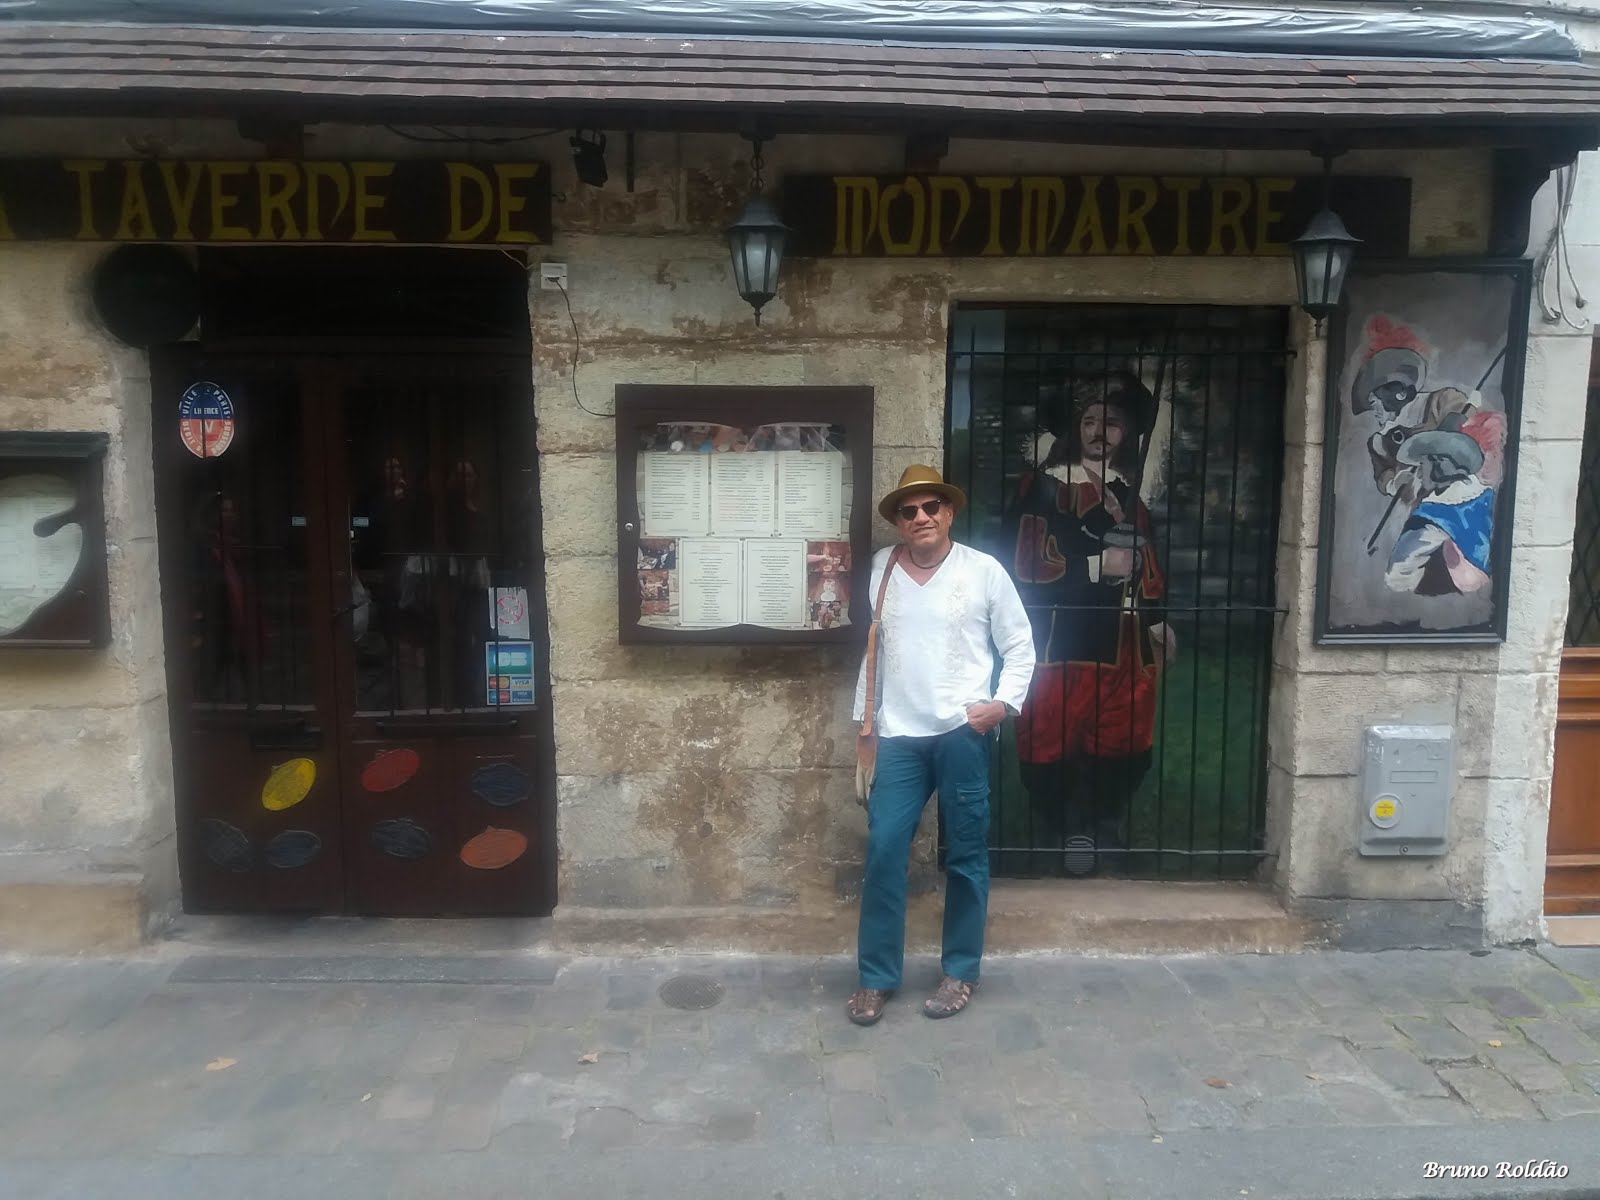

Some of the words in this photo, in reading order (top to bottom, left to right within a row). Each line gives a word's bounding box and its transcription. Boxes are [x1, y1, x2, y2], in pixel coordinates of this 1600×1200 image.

[444, 162, 541, 243] DE
[182, 390, 198, 415] VILLE
[213, 389, 231, 416] PARIS
